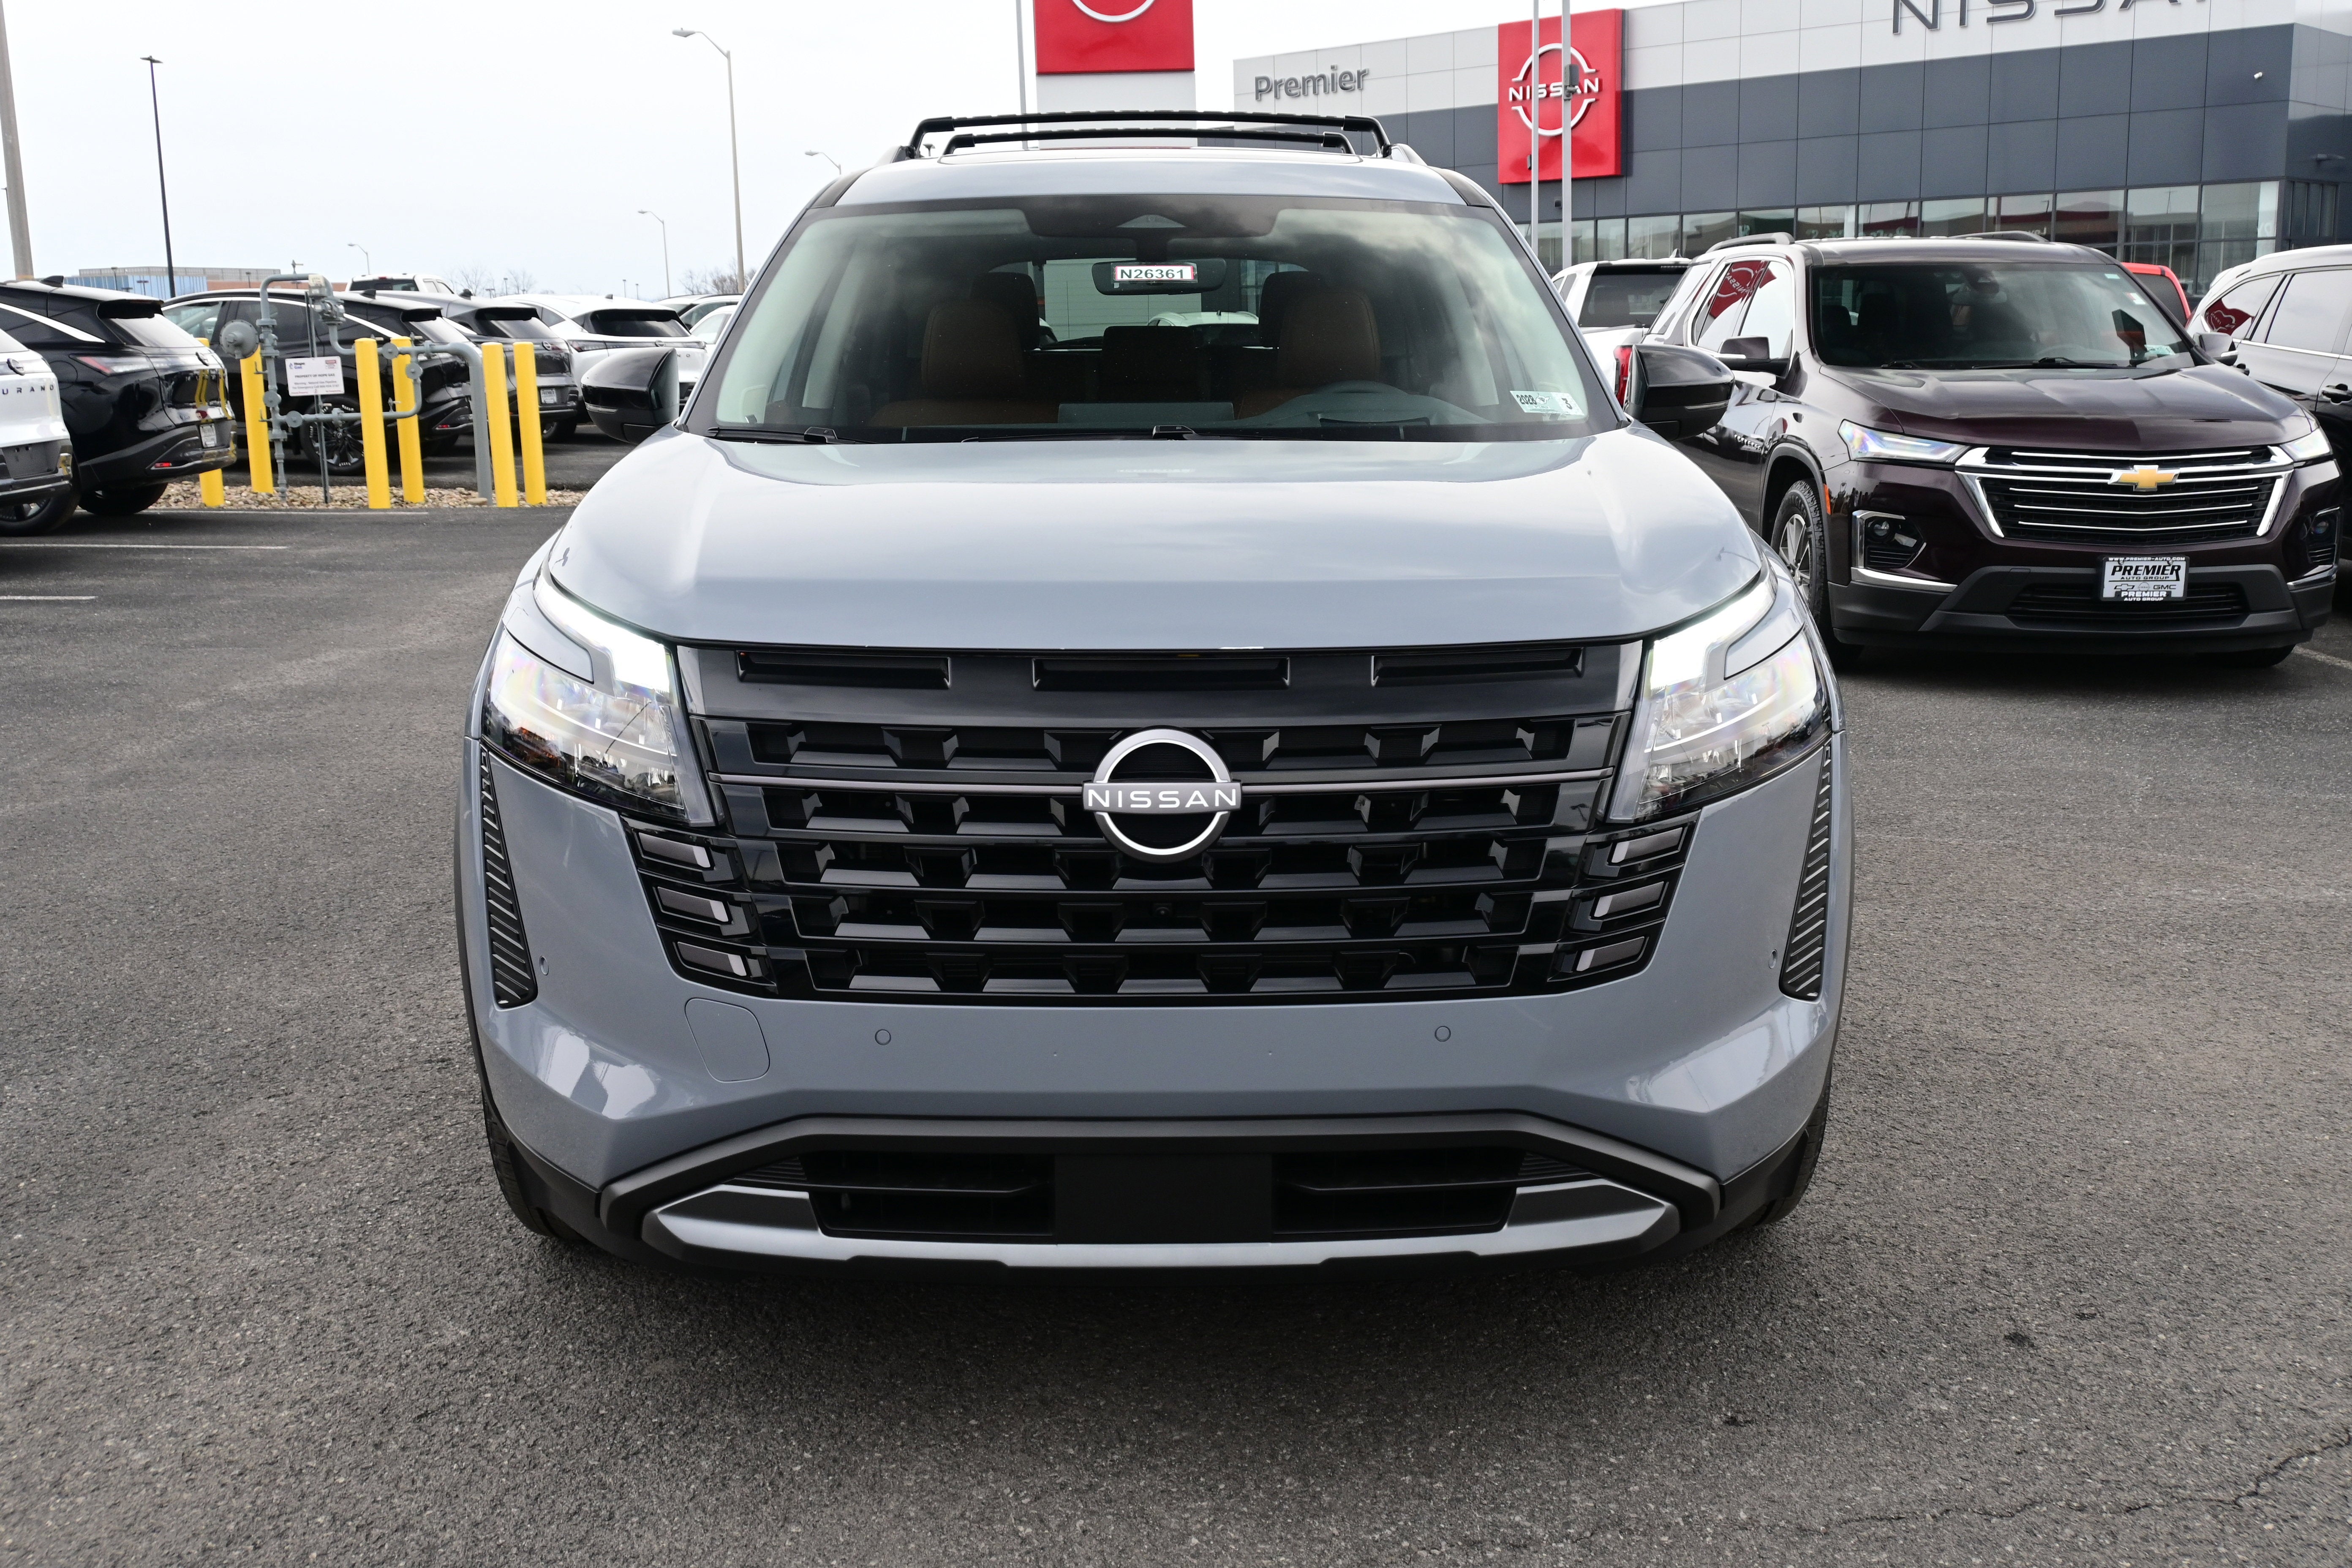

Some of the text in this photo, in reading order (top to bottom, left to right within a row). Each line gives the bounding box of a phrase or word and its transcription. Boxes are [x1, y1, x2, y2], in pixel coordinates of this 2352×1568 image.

[1255, 64, 1369, 101] Premier
[1509, 77, 1599, 102] NISSN
[1121, 269, 1183, 278] N26361
[1516, 395, 1537, 405] 2028
[1562, 397, 1573, 410] 3
[2111, 565, 2181, 578] PREMIER
[1088, 789, 1236, 808] NISSAN
